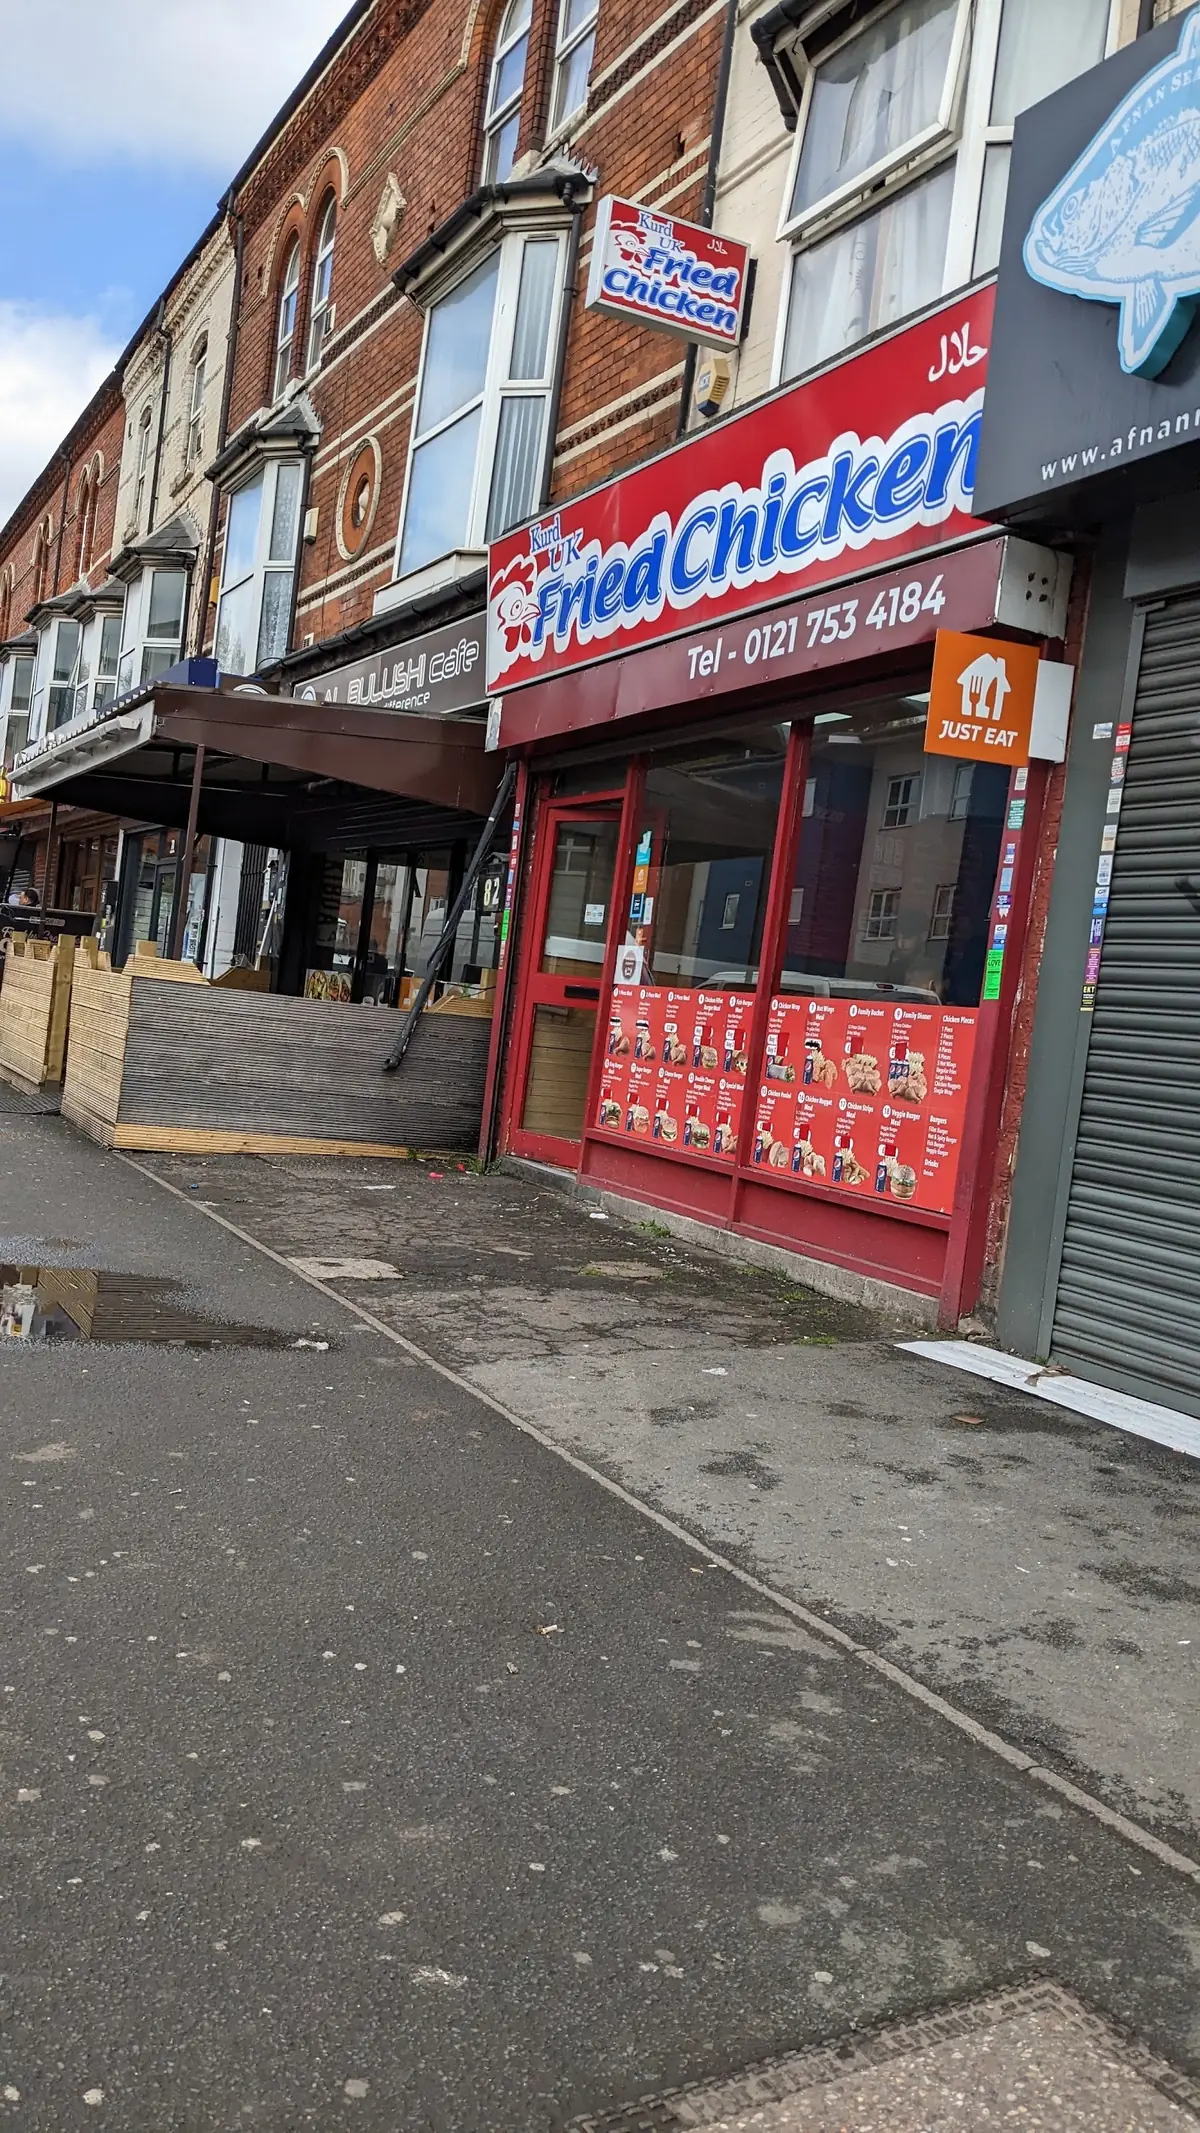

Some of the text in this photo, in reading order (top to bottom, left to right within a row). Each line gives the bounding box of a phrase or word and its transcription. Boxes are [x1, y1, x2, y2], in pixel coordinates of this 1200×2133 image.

[1110, 85, 1166, 157] AFNAN
[639, 213, 673, 237] Kurd
[659, 237, 684, 252] UK
[642, 247, 737, 296] Fried
[604, 267, 736, 330] Chicken
[530, 515, 561, 553] Kurd
[532, 408, 983, 647] Fried Chicken
[549, 531, 583, 572] UK
[687, 637, 723, 679] Tel
[744, 616, 799, 664] 0121
[806, 598, 859, 648] 753
[865, 574, 946, 630] 4184
[347, 653, 426, 705] BULUSHI
[938, 720, 1018, 748] JUST EAT
[484, 877, 500, 906] 82
[943, 1015, 960, 1023] Chicken
[906, 1112, 921, 1121] Burger
[930, 1115, 947, 1125] Burgers
[924, 1158, 938, 1168] Drinks
